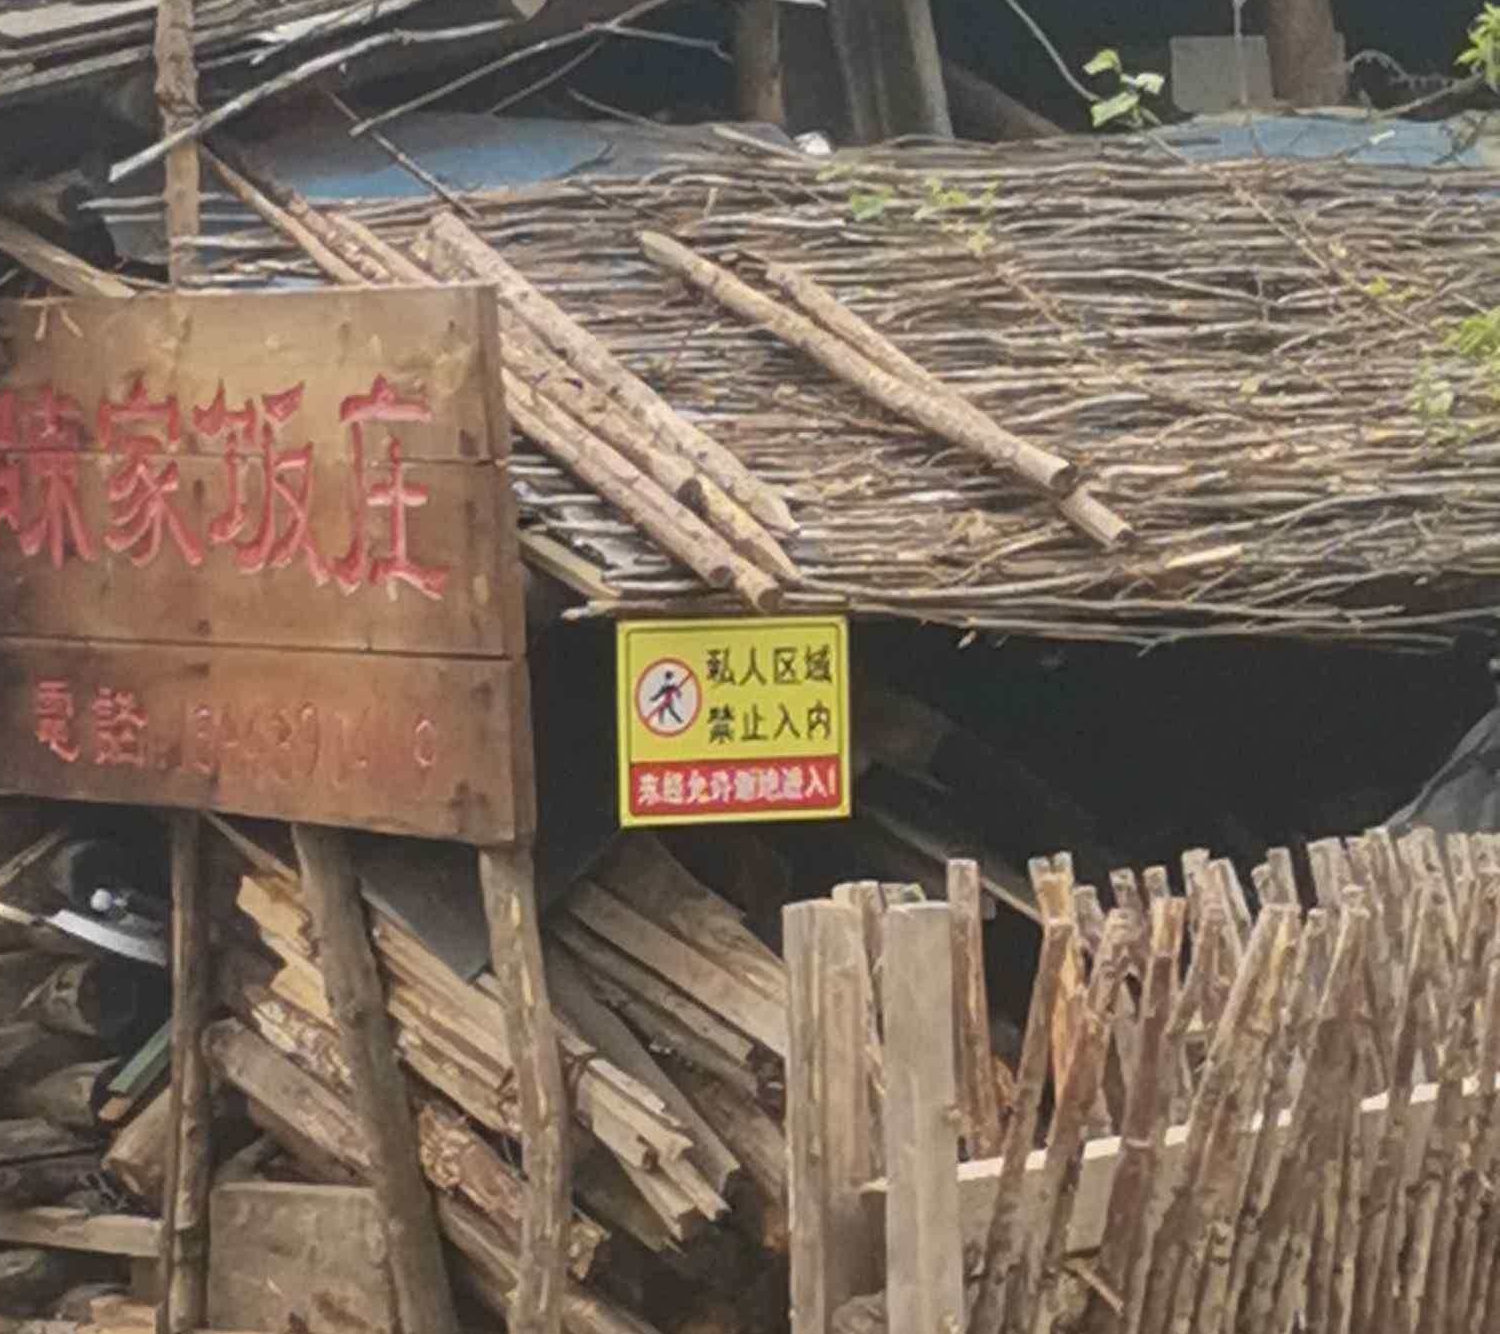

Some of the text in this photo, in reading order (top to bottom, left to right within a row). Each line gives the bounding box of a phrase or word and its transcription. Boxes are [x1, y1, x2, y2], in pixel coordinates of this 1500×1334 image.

[706, 644, 833, 686] 私人区域
[706, 699, 832, 744] 禁止入内
